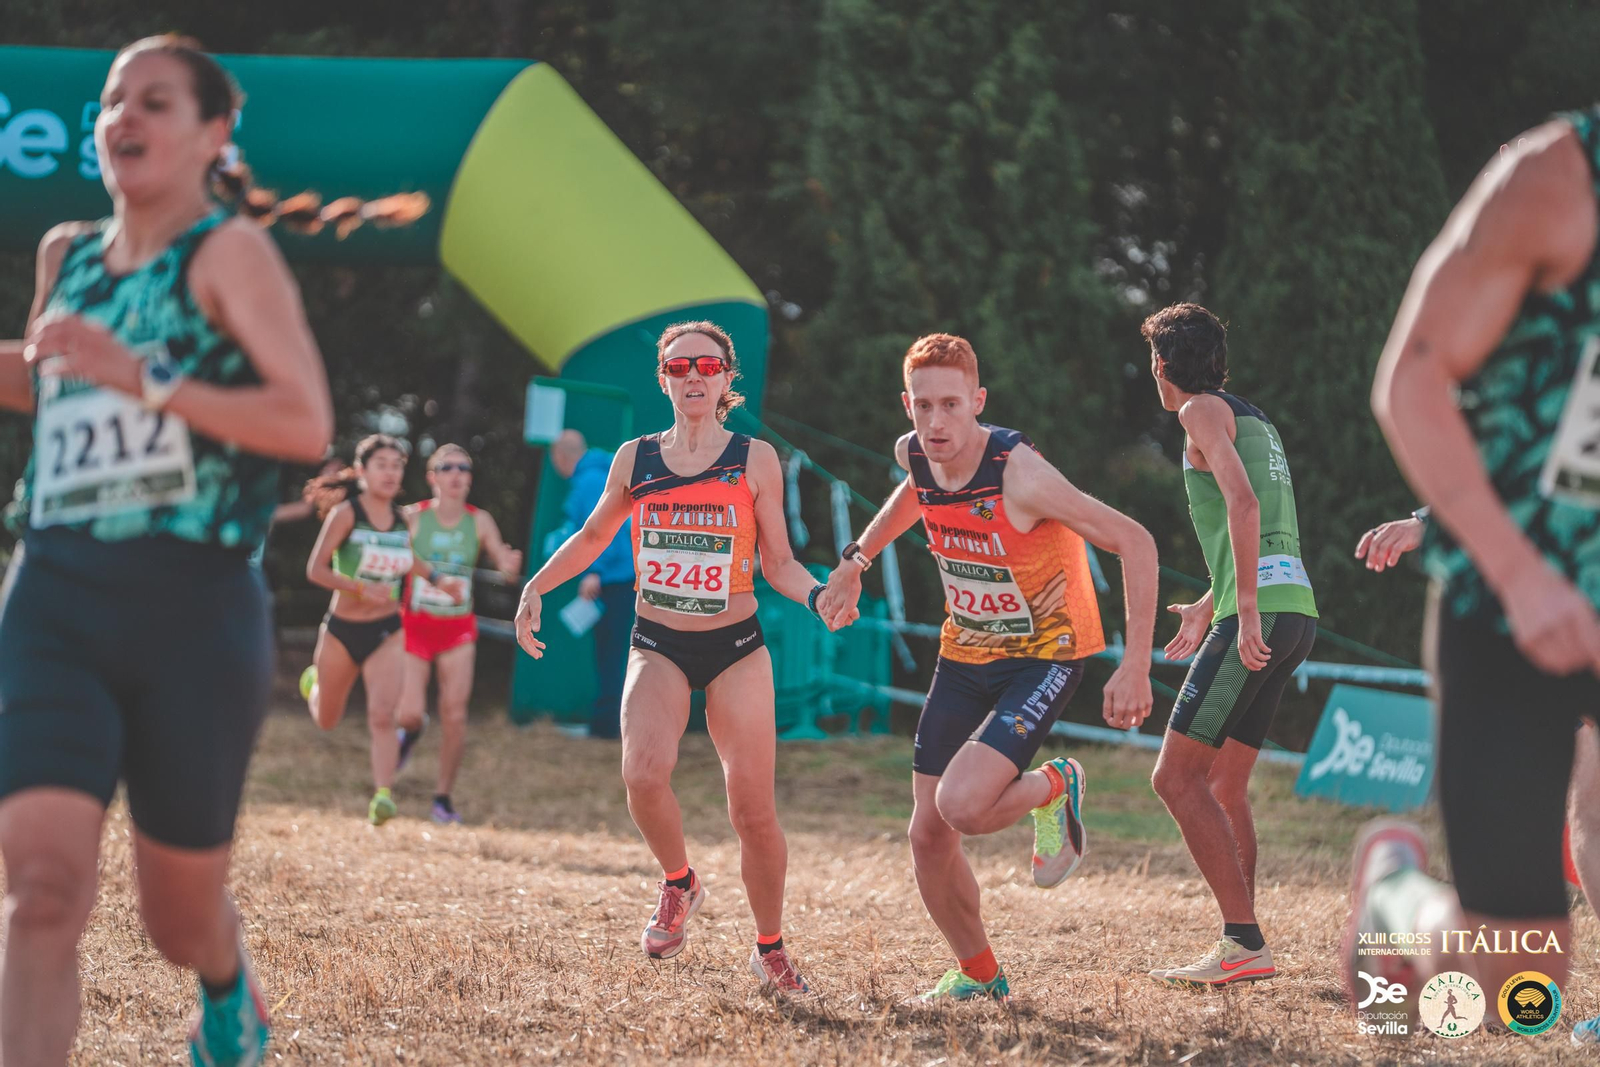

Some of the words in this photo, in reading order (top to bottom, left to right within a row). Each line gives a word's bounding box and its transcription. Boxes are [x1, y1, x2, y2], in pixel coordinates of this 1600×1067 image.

[51, 411, 172, 477] 2212
[639, 503, 661, 526] LA
[670, 504, 738, 528] ZUBIA
[647, 502, 669, 511] Club
[672, 503, 724, 512] Deportivo
[665, 534, 709, 546] ITÁLICA
[940, 524, 988, 541] Deportivo
[941, 532, 1008, 556] ZUBIA
[647, 560, 723, 592] 2248
[951, 562, 990, 577] ITÁLICA
[948, 584, 1021, 615] 2248
[1022, 701, 1049, 721] LA
[1367, 751, 1426, 786] Sevilla
